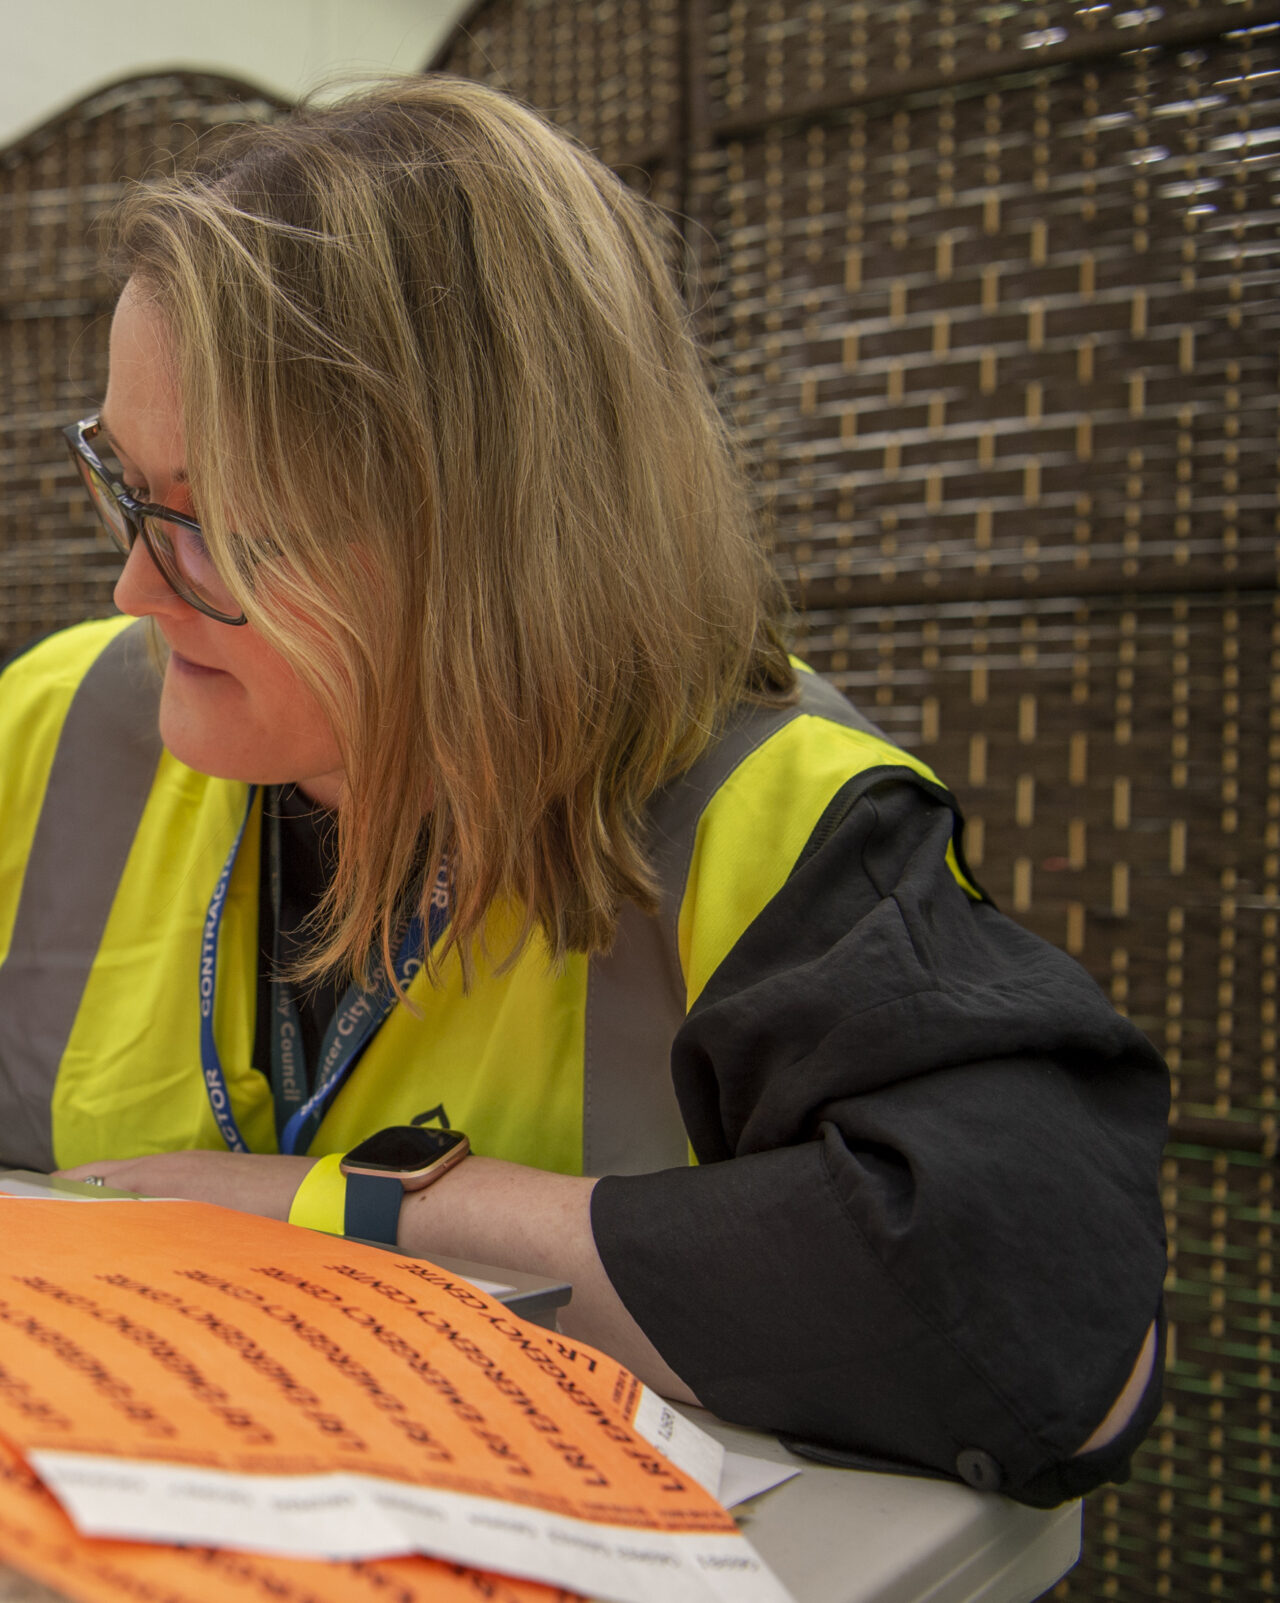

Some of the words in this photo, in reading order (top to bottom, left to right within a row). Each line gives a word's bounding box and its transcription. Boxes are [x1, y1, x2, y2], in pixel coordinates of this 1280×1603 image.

[337, 995, 372, 1036] City
[280, 1020, 301, 1102] Council
[11, 1275, 99, 1308] CENTRE
[94, 1274, 183, 1305] CENTRE
[173, 1269, 265, 1301] CENTRE
[250, 1266, 343, 1302] CENTRE
[322, 1264, 418, 1305] CENTRE
[394, 1263, 489, 1311] CENTRE
[0, 1310, 133, 1399] EMERGENCY
[90, 1307, 229, 1403] EMERGENCY
[175, 1303, 322, 1406] EMERGENCY
[252, 1303, 405, 1413] EMERGENCY
[329, 1303, 485, 1424] EMERGENCY
[405, 1306, 562, 1435] EMERGENCY
[477, 1311, 634, 1443] EMERGENCY
[208, 1402, 276, 1446] LRF
[301, 1408, 367, 1453] LRF
[388, 1414, 455, 1464] LRF
[471, 1424, 534, 1477] LRF
[548, 1436, 610, 1488] LRF
[621, 1448, 687, 1493] LRF
